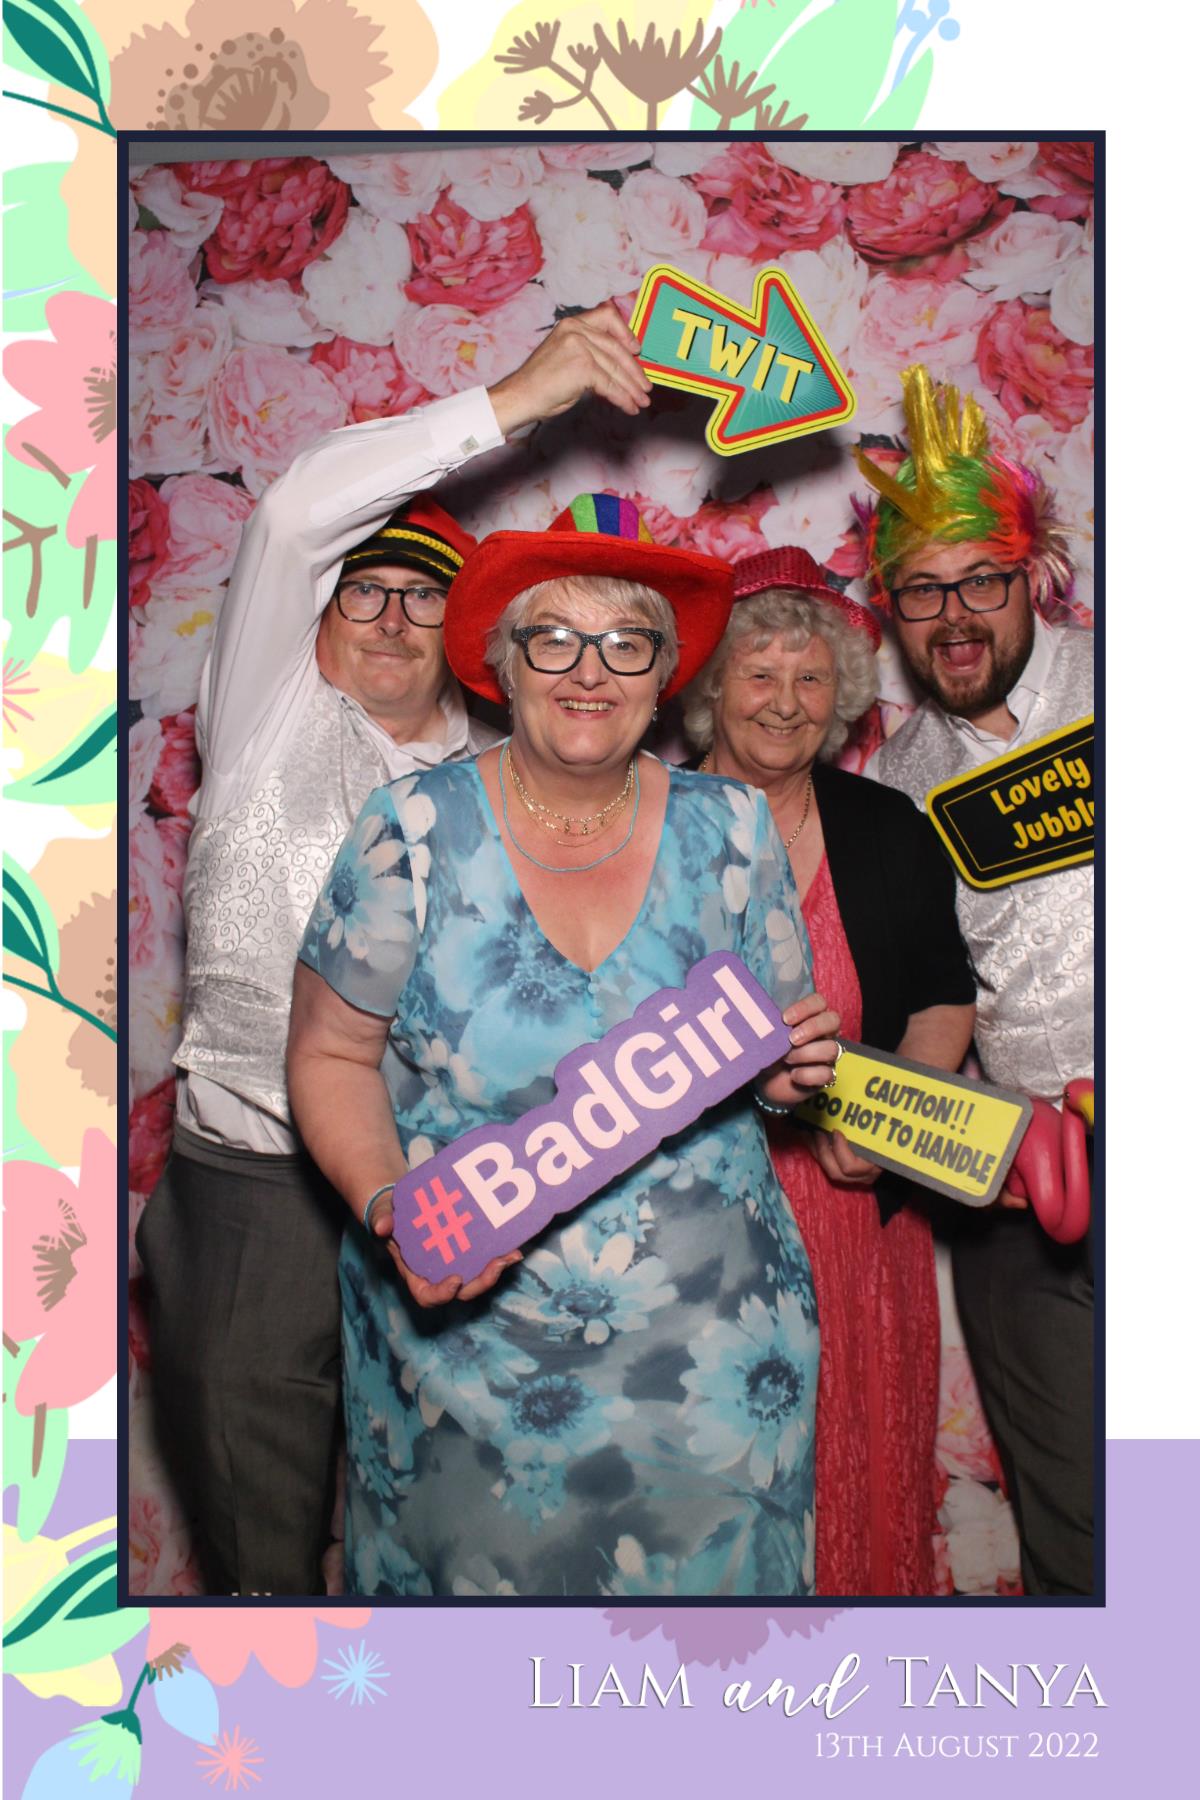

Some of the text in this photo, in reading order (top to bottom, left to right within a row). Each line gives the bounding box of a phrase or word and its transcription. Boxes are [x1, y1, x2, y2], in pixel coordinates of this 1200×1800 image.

[672, 308, 815, 404] TWIT
[990, 758, 1091, 815] Lovely
[1012, 798, 1094, 849] Jubbl
[411, 965, 775, 1265] #BadGirl
[806, 1091, 997, 1185] OO HOT TO HANDLE
[864, 1076, 975, 1134] CAUTION!!
